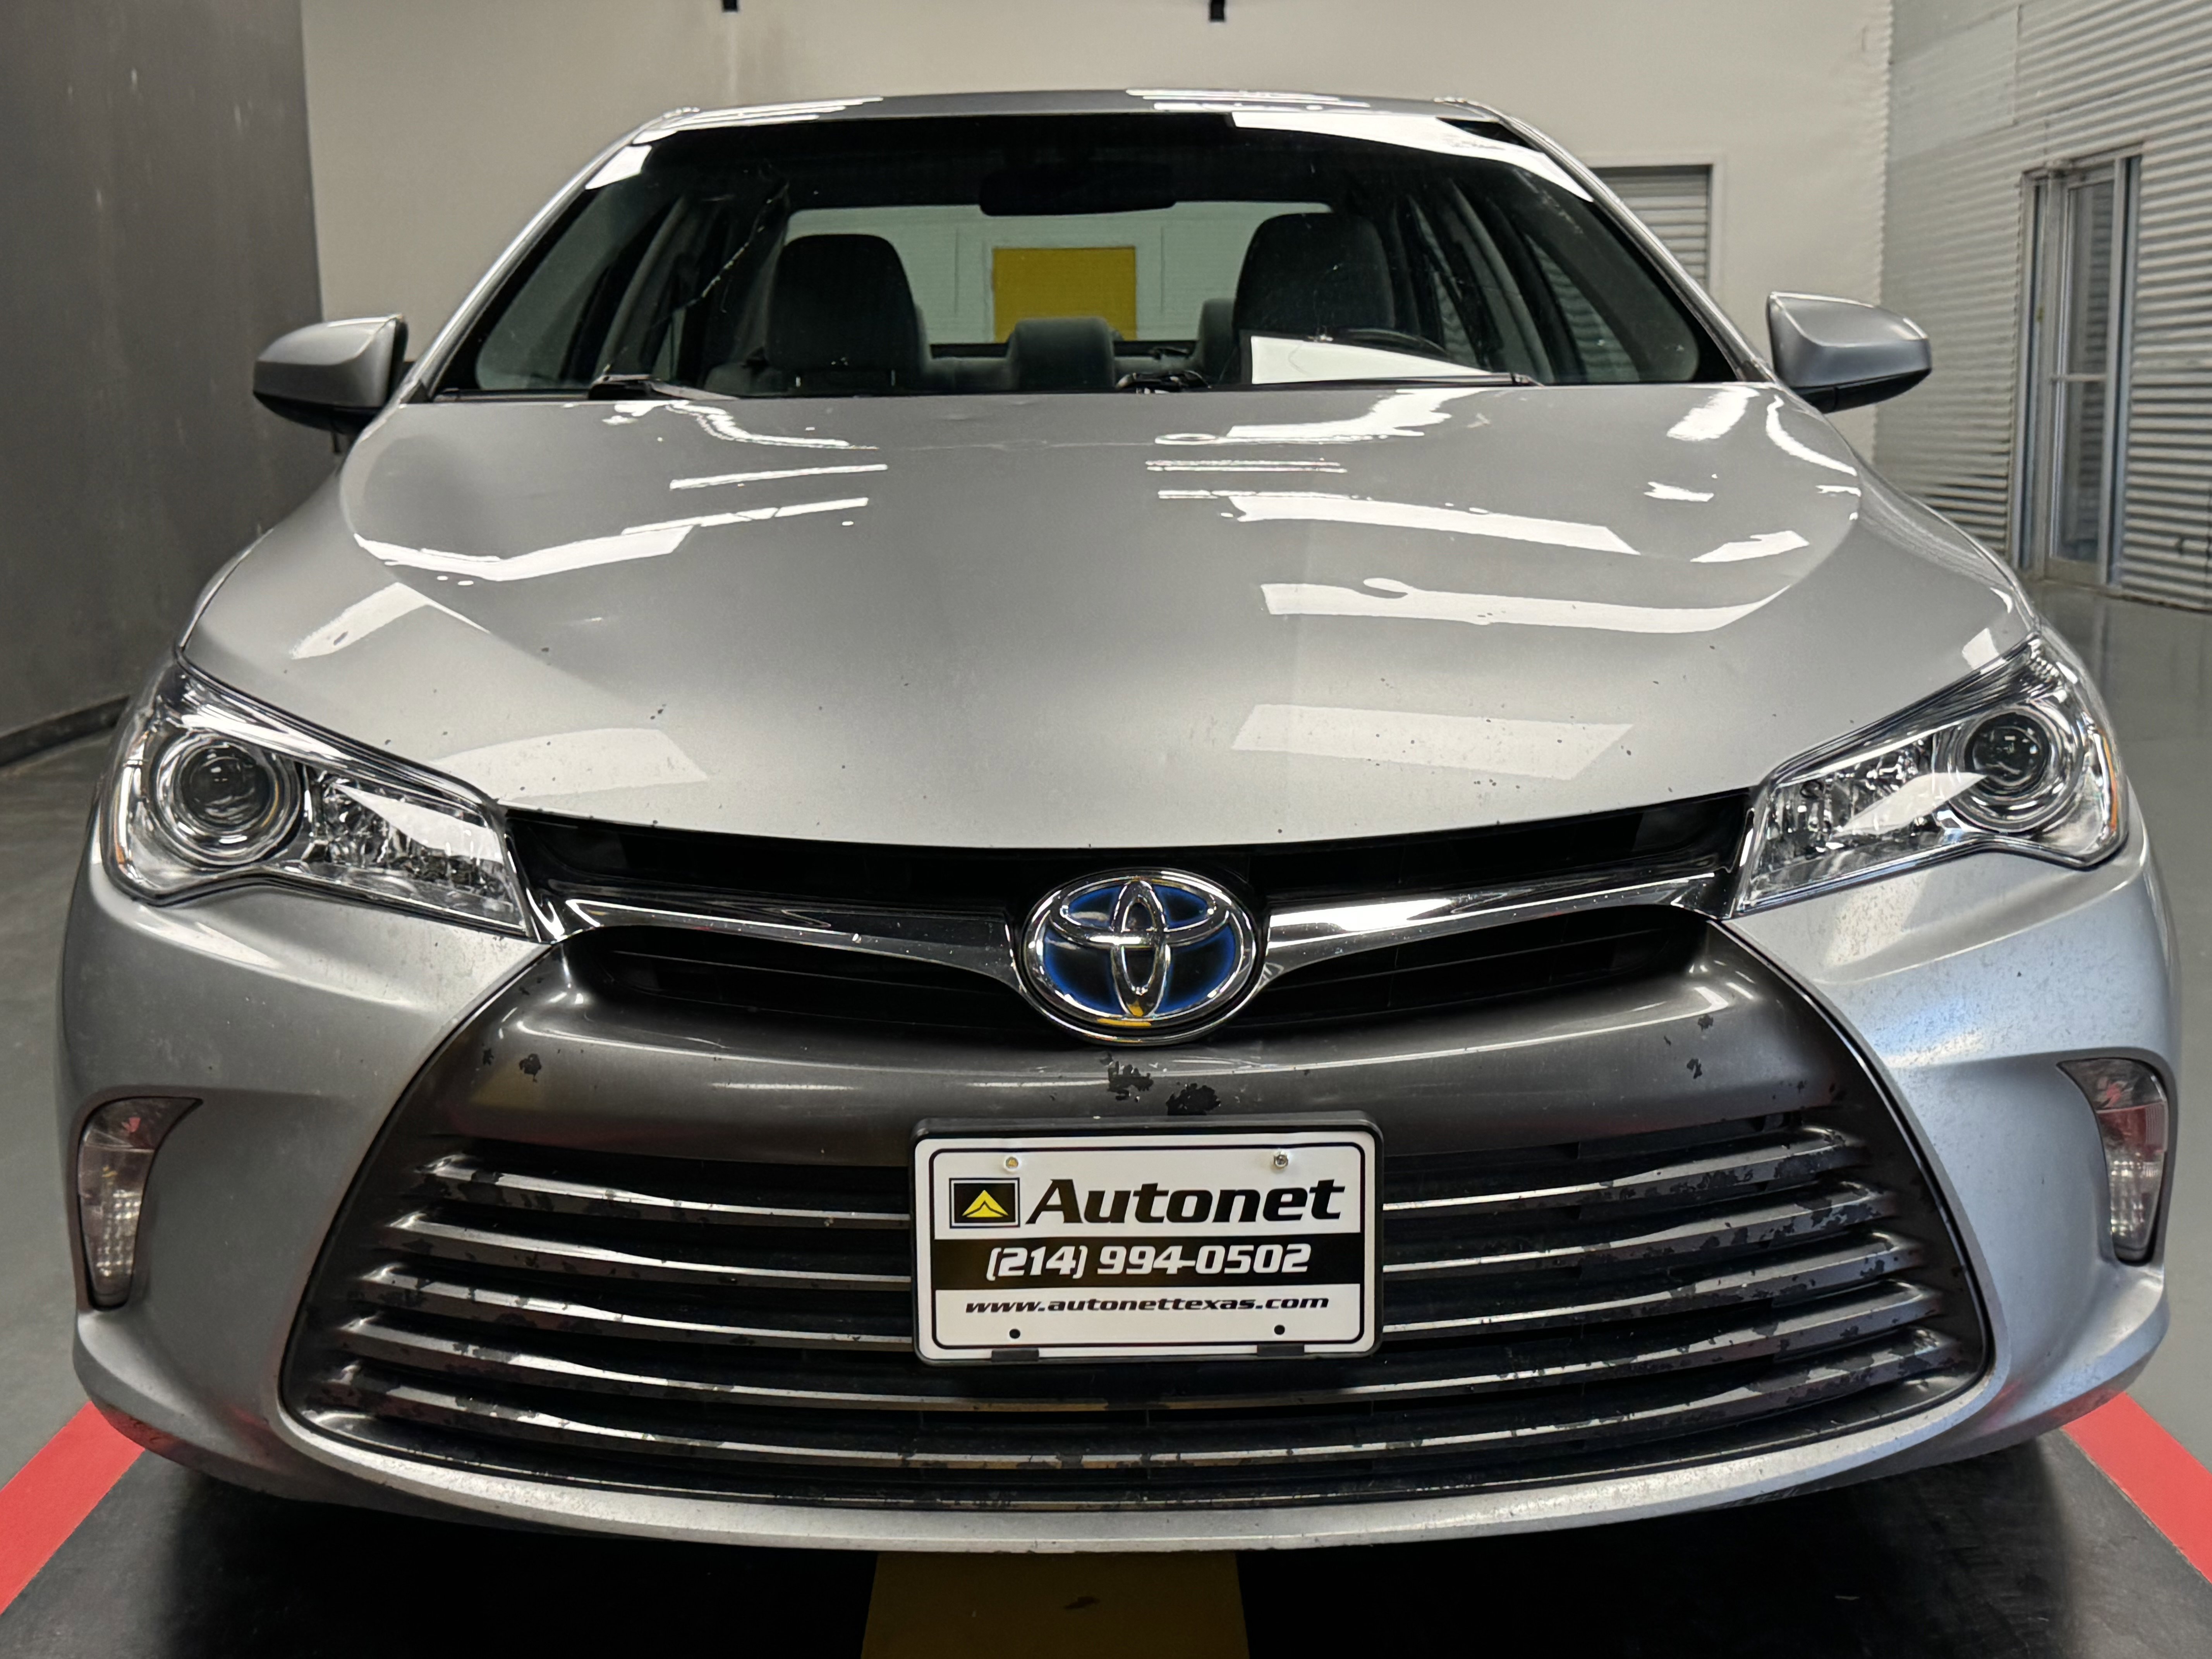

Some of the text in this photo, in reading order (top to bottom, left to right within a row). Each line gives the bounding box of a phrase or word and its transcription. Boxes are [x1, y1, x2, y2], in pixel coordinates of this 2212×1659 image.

[1025, 1179, 1346, 1225] Autonet
[986, 1243, 1312, 1281] (214) 994-0502
[965, 1297, 1329, 1313] www.autonettexas.com
